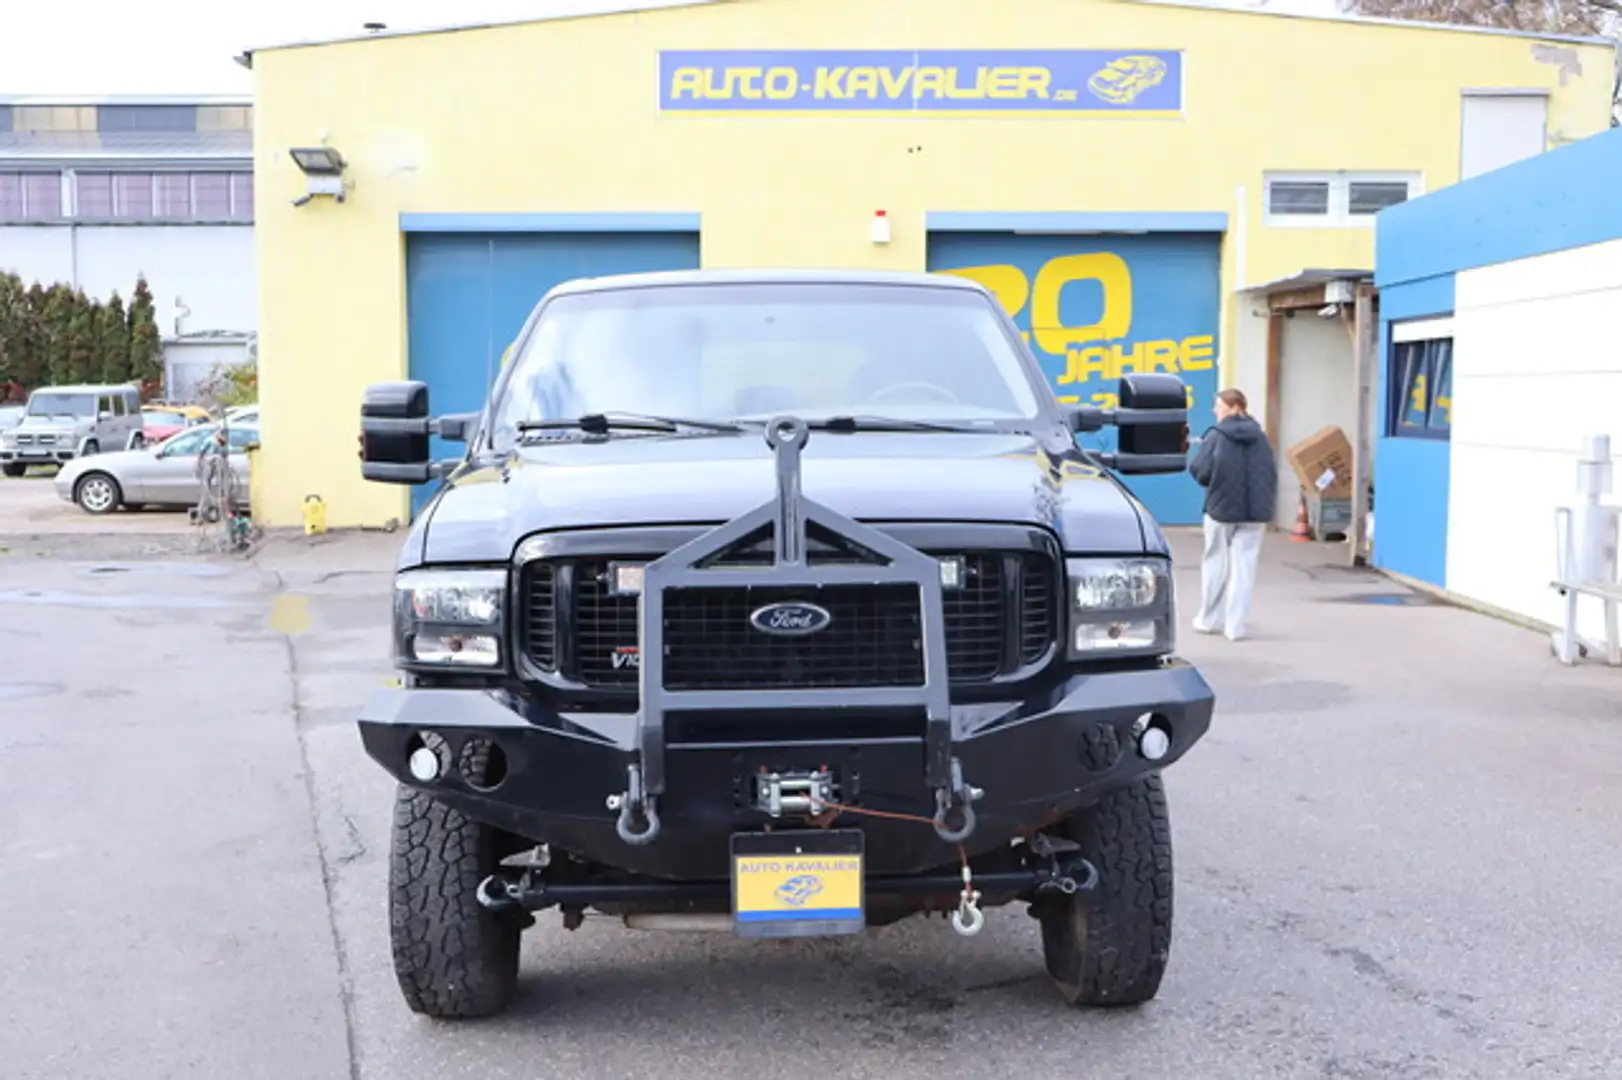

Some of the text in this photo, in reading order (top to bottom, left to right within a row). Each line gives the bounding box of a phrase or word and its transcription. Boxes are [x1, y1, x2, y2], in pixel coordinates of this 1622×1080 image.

[1056, 335, 1213, 385] JAHRE
[769, 607, 813, 628] Ford
[740, 859, 859, 873] AUTO KAVALIER
